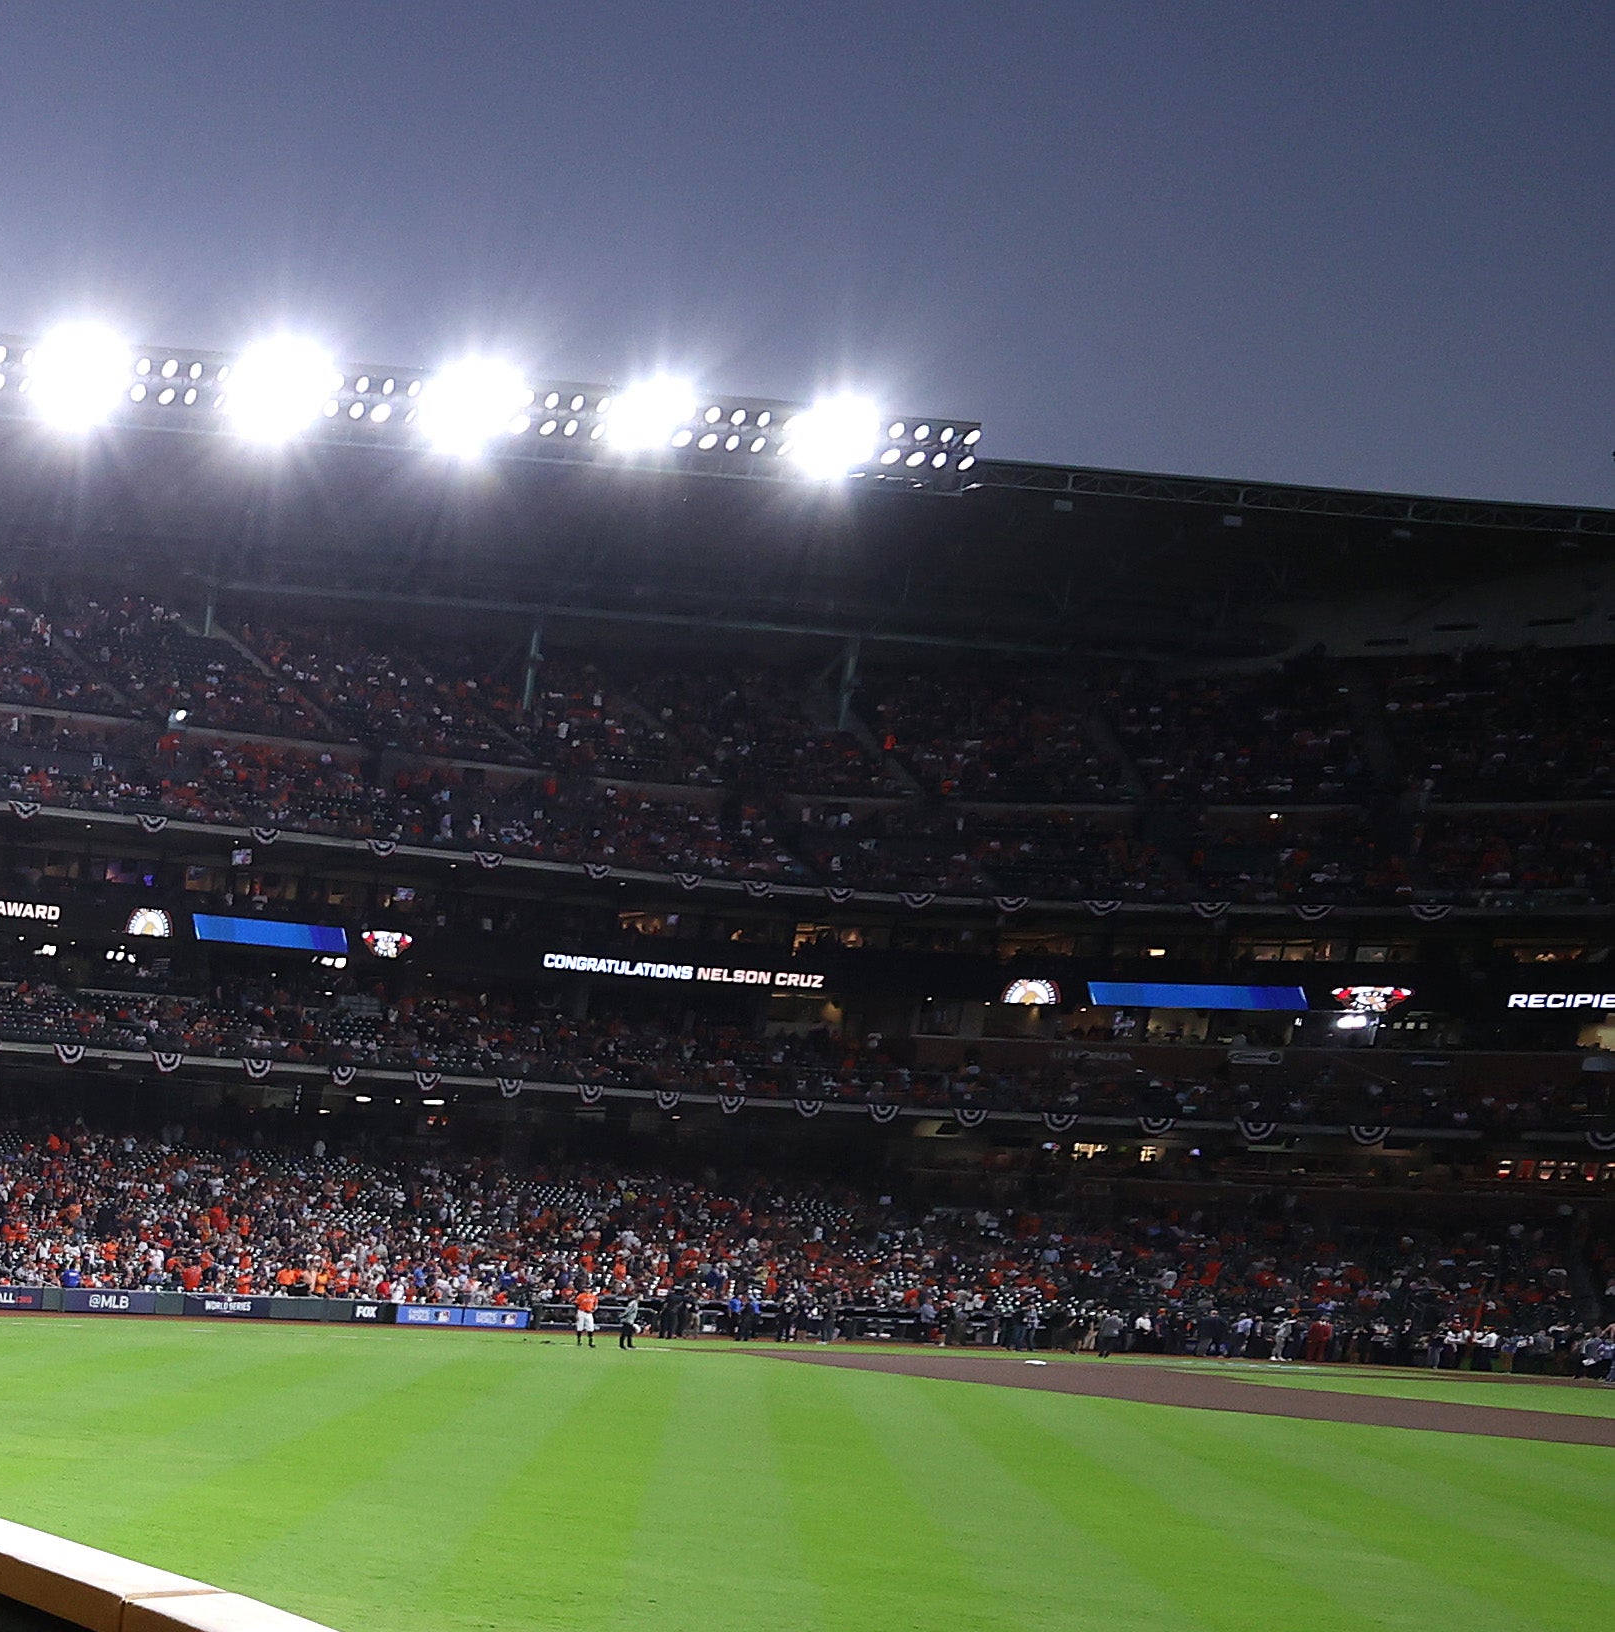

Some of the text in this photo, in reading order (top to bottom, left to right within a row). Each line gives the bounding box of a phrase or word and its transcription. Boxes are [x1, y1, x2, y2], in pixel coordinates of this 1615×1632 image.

[543, 953, 825, 988] CONGRATULATIONS NELSON CRUZ
[88, 1294, 129, 1309] @MLB
[205, 1300, 251, 1311] WORLD SERIES
[355, 1305, 379, 1318] FOX
